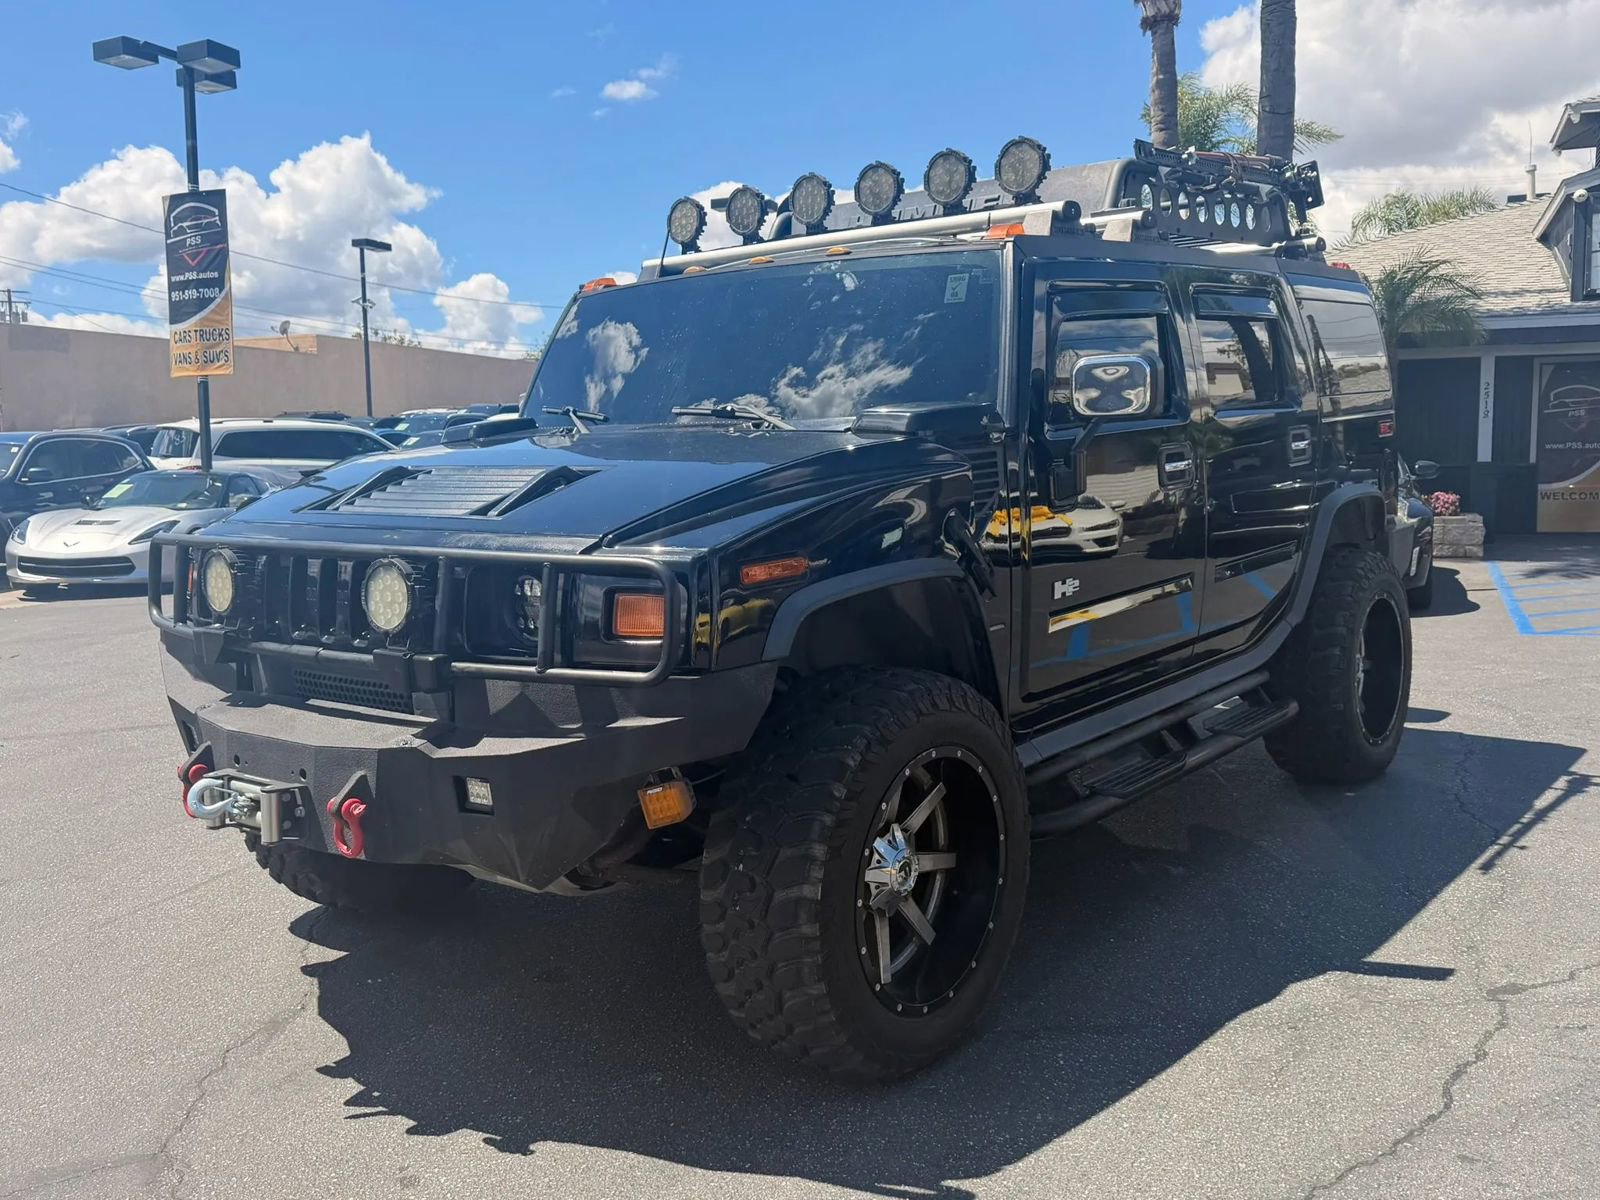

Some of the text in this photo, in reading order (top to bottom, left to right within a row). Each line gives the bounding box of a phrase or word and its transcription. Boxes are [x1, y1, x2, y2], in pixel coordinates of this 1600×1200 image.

[186, 235, 201, 247] PSS
[171, 271, 218, 282] www.PSS.autos
[171, 288, 219, 301] 951-519-7008
[173, 327, 230, 344] CARS TRUCKS
[173, 349, 230, 366] VANS & SUV'S
[1054, 577, 1080, 600] H2
